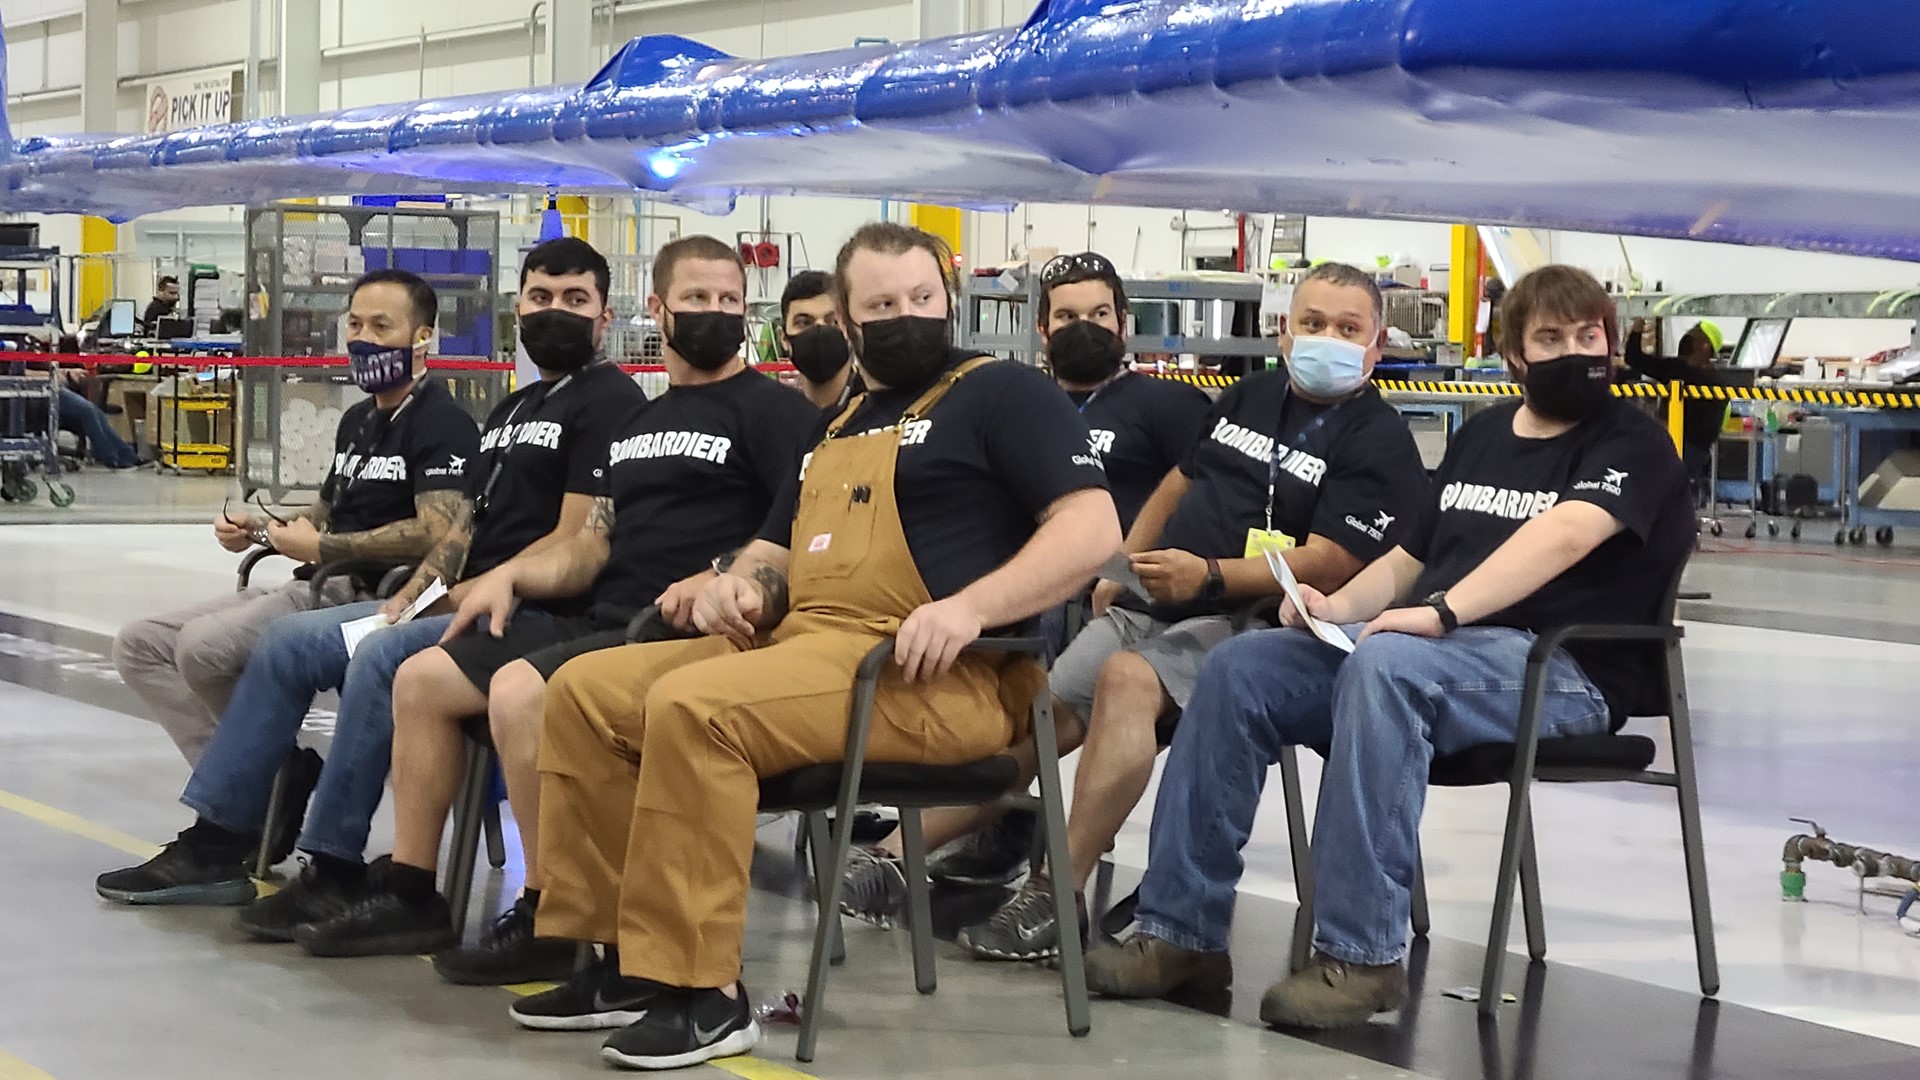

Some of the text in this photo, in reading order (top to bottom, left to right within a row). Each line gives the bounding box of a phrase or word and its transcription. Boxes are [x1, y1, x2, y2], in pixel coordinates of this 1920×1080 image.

[170, 90, 231, 124] PICK IT UP
[1440, 481, 1559, 520] BOMBARDER
